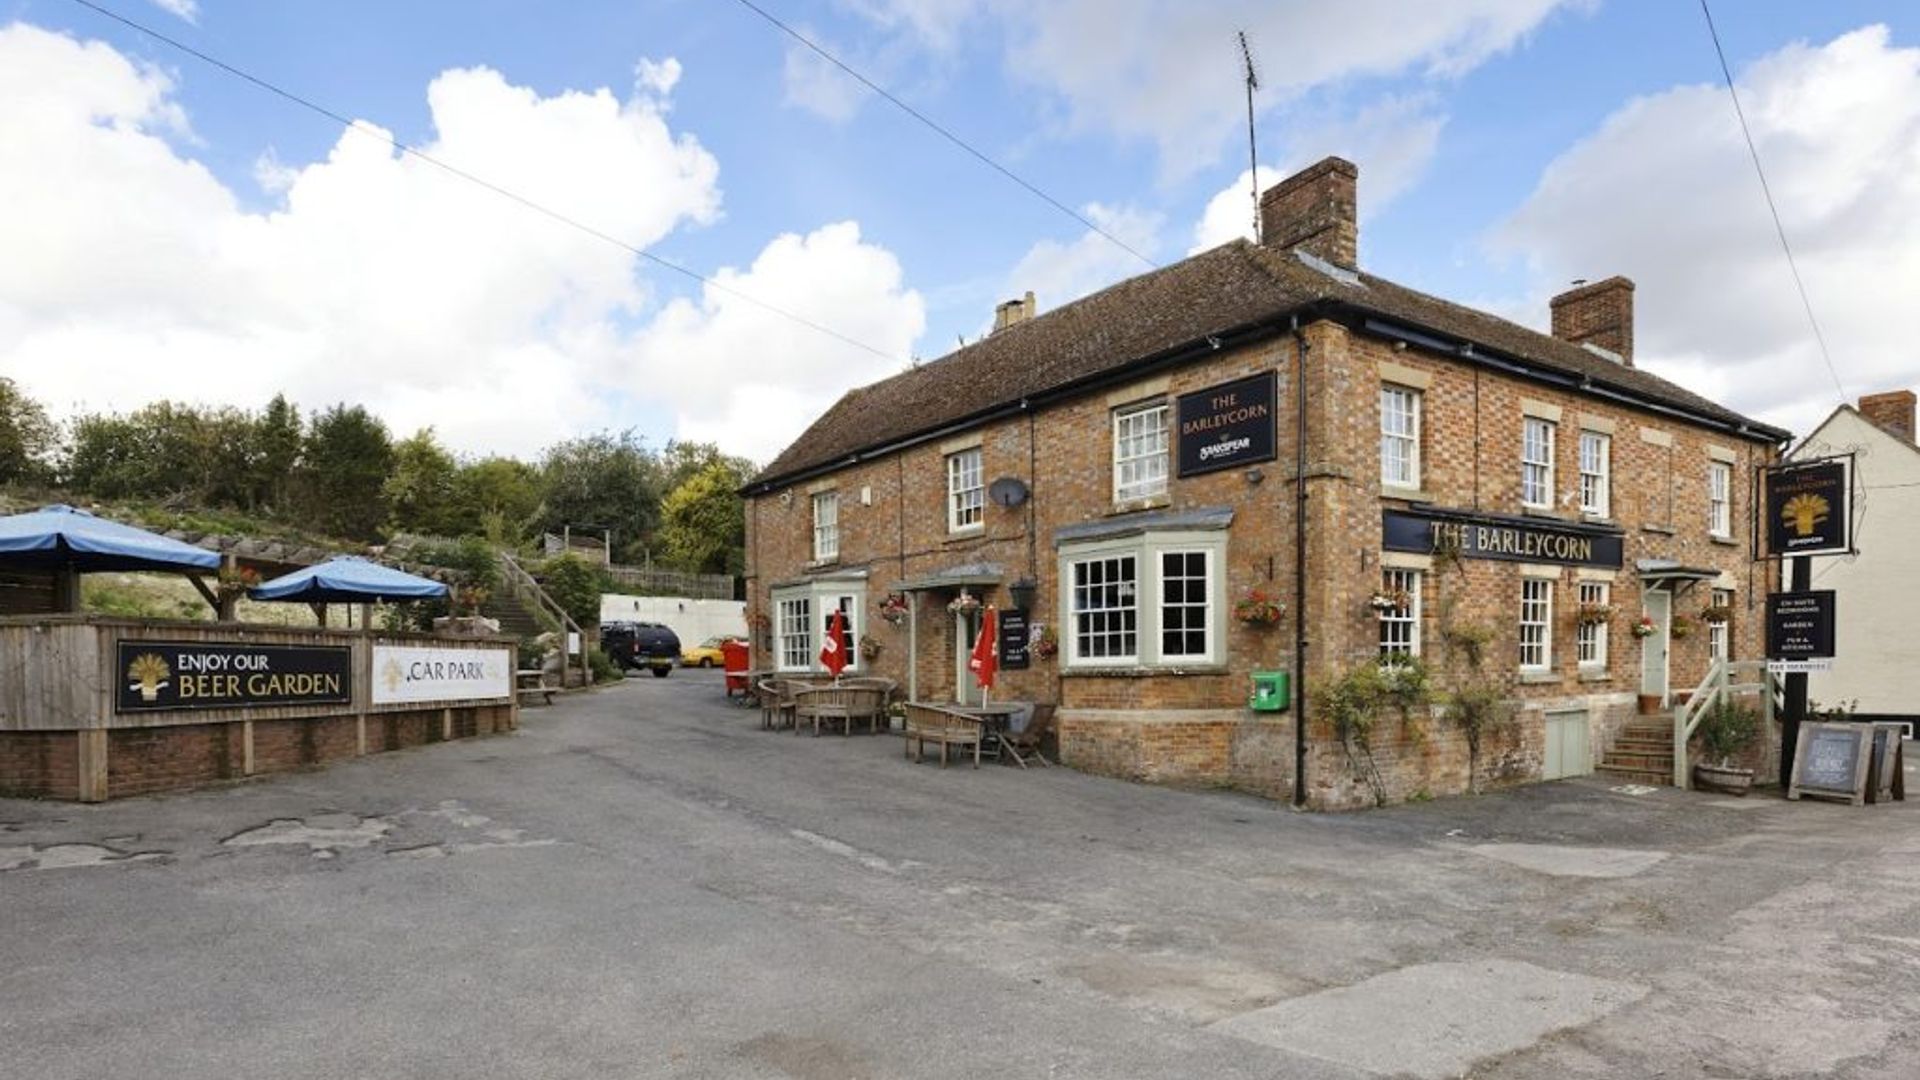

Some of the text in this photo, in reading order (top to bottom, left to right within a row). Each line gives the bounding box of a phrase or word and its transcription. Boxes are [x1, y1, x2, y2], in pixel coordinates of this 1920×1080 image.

[1212, 393, 1238, 410] THE
[1182, 404, 1267, 435] BARLEYCORN
[1430, 521, 1592, 560] THE BARLEYCORN
[177, 653, 270, 673] ENJOY OUR
[409, 661, 484, 681] CAR PARK
[179, 673, 340, 698] BEER GARDEN
